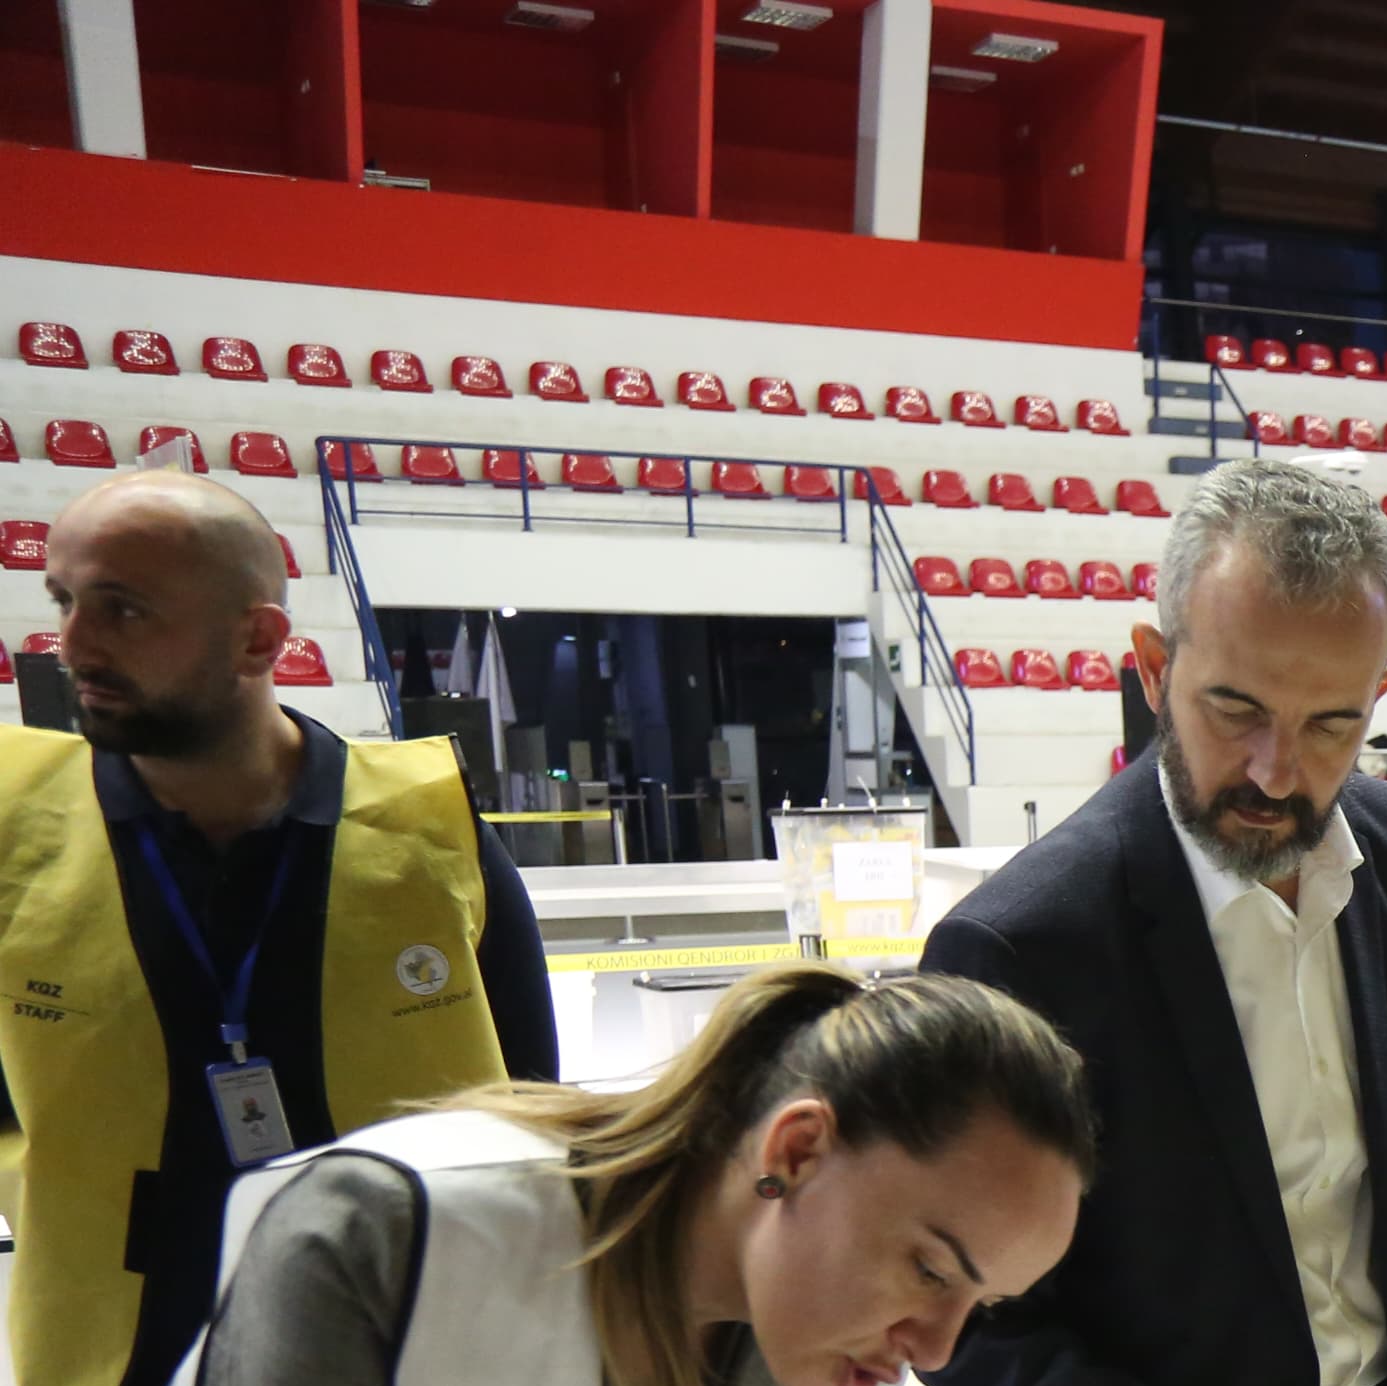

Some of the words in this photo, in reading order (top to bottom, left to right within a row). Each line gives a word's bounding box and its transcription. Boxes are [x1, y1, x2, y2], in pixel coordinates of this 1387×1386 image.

[586, 953, 673, 970] KOMISIONI
[678, 948, 757, 966] QENDROR
[27, 980, 63, 999] KQZ
[14, 1003, 65, 1022] STAFF
